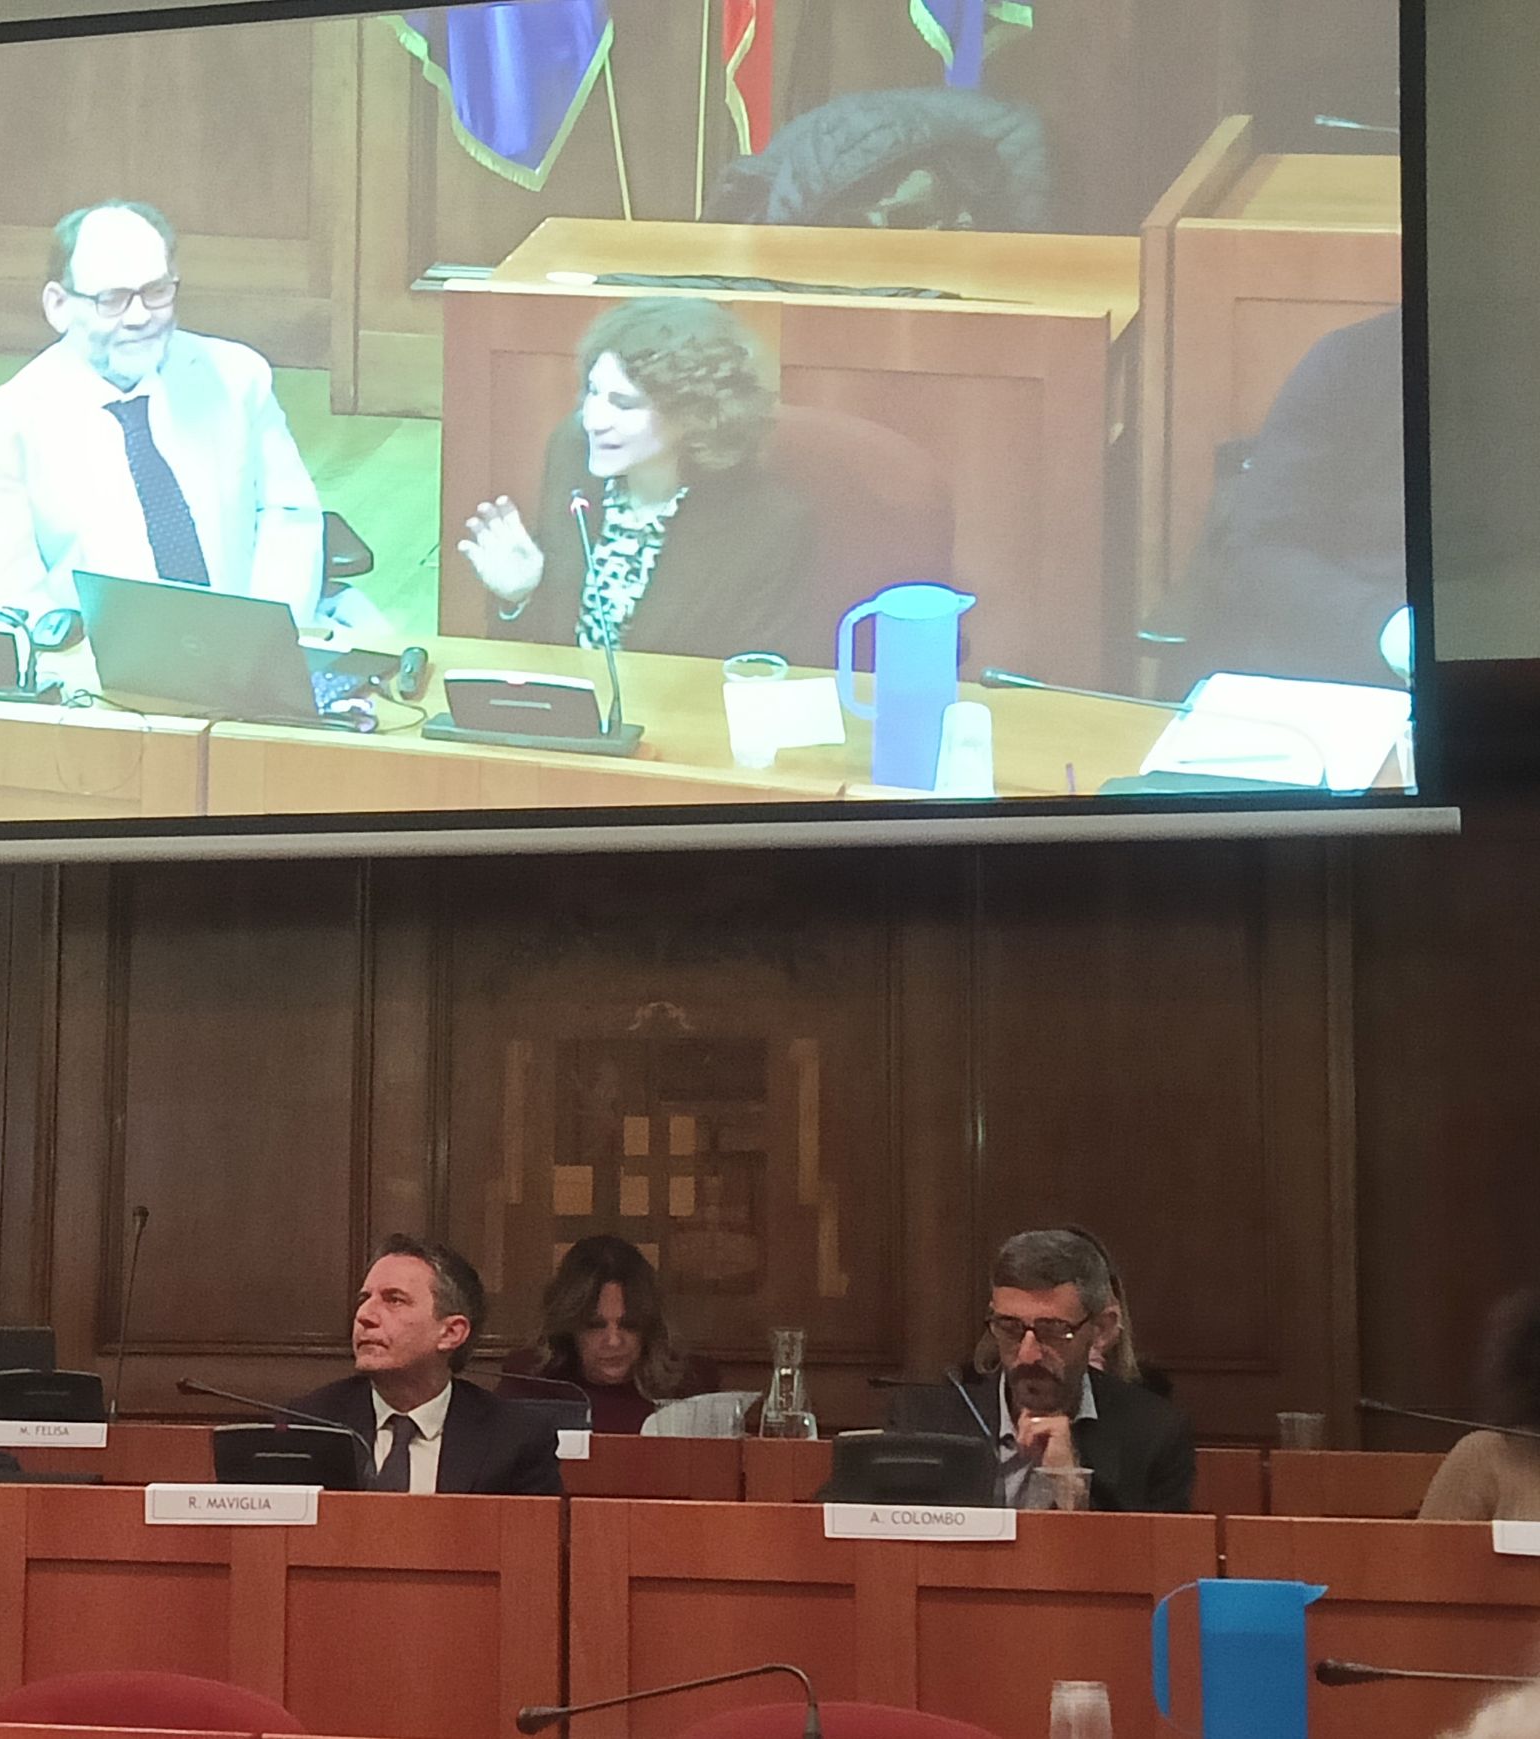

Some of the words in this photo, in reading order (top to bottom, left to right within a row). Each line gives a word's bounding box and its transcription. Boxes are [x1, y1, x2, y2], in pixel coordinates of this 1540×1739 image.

[35, 1426, 70, 1437] FELISA
[188, 1496, 201, 1509] R.
[206, 1496, 272, 1510] MAVIGLIA
[869, 1511, 884, 1524] A.
[891, 1511, 966, 1526] COLOMBO
